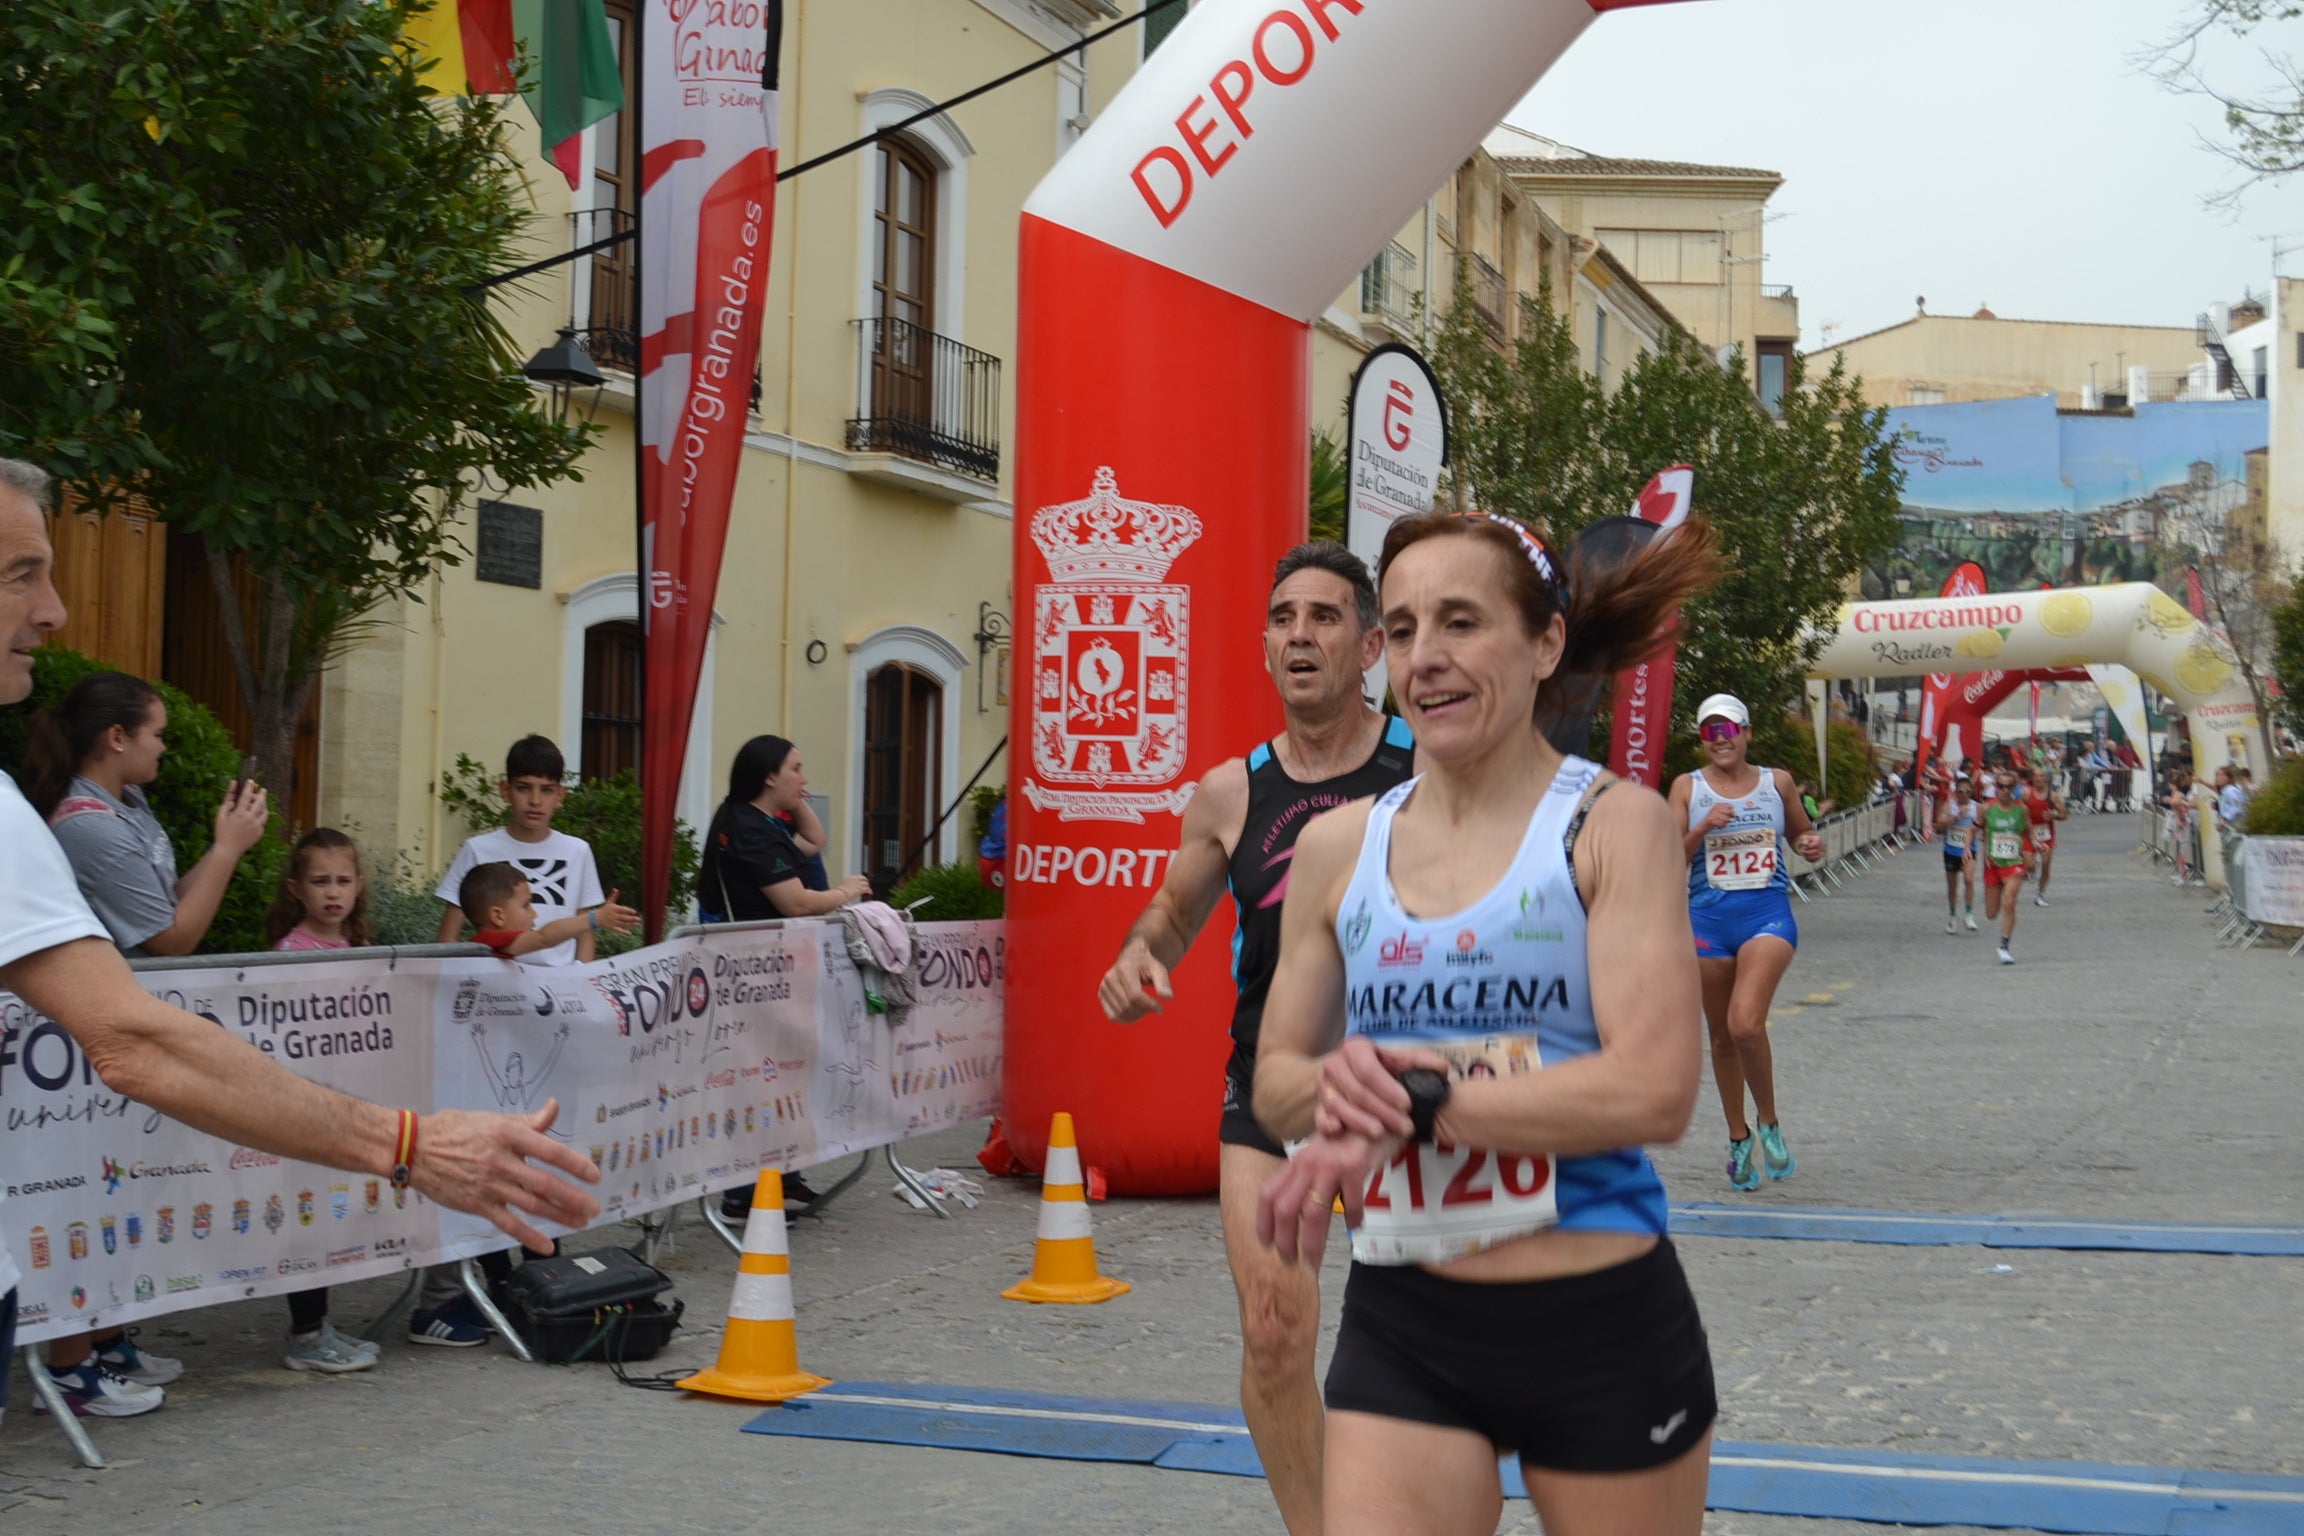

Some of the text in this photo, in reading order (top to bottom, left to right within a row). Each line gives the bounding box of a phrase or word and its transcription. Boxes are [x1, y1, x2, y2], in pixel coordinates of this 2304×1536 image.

[1358, 439, 1428, 489] Diputación
[1356, 467, 1428, 513] de Granada
[1854, 604, 2024, 633] Cruzcampo
[1871, 640, 1953, 665] Radler
[1068, 805, 1131, 816] GRANADA
[1712, 849, 1776, 876] 2124
[597, 965, 649, 992] GRAN
[714, 948, 795, 986] Diputación
[733, 977, 792, 1005] Granada
[238, 985, 392, 1034] Diputación
[284, 1021, 394, 1060] Granada
[22, 1174, 88, 1195] GRANADA
